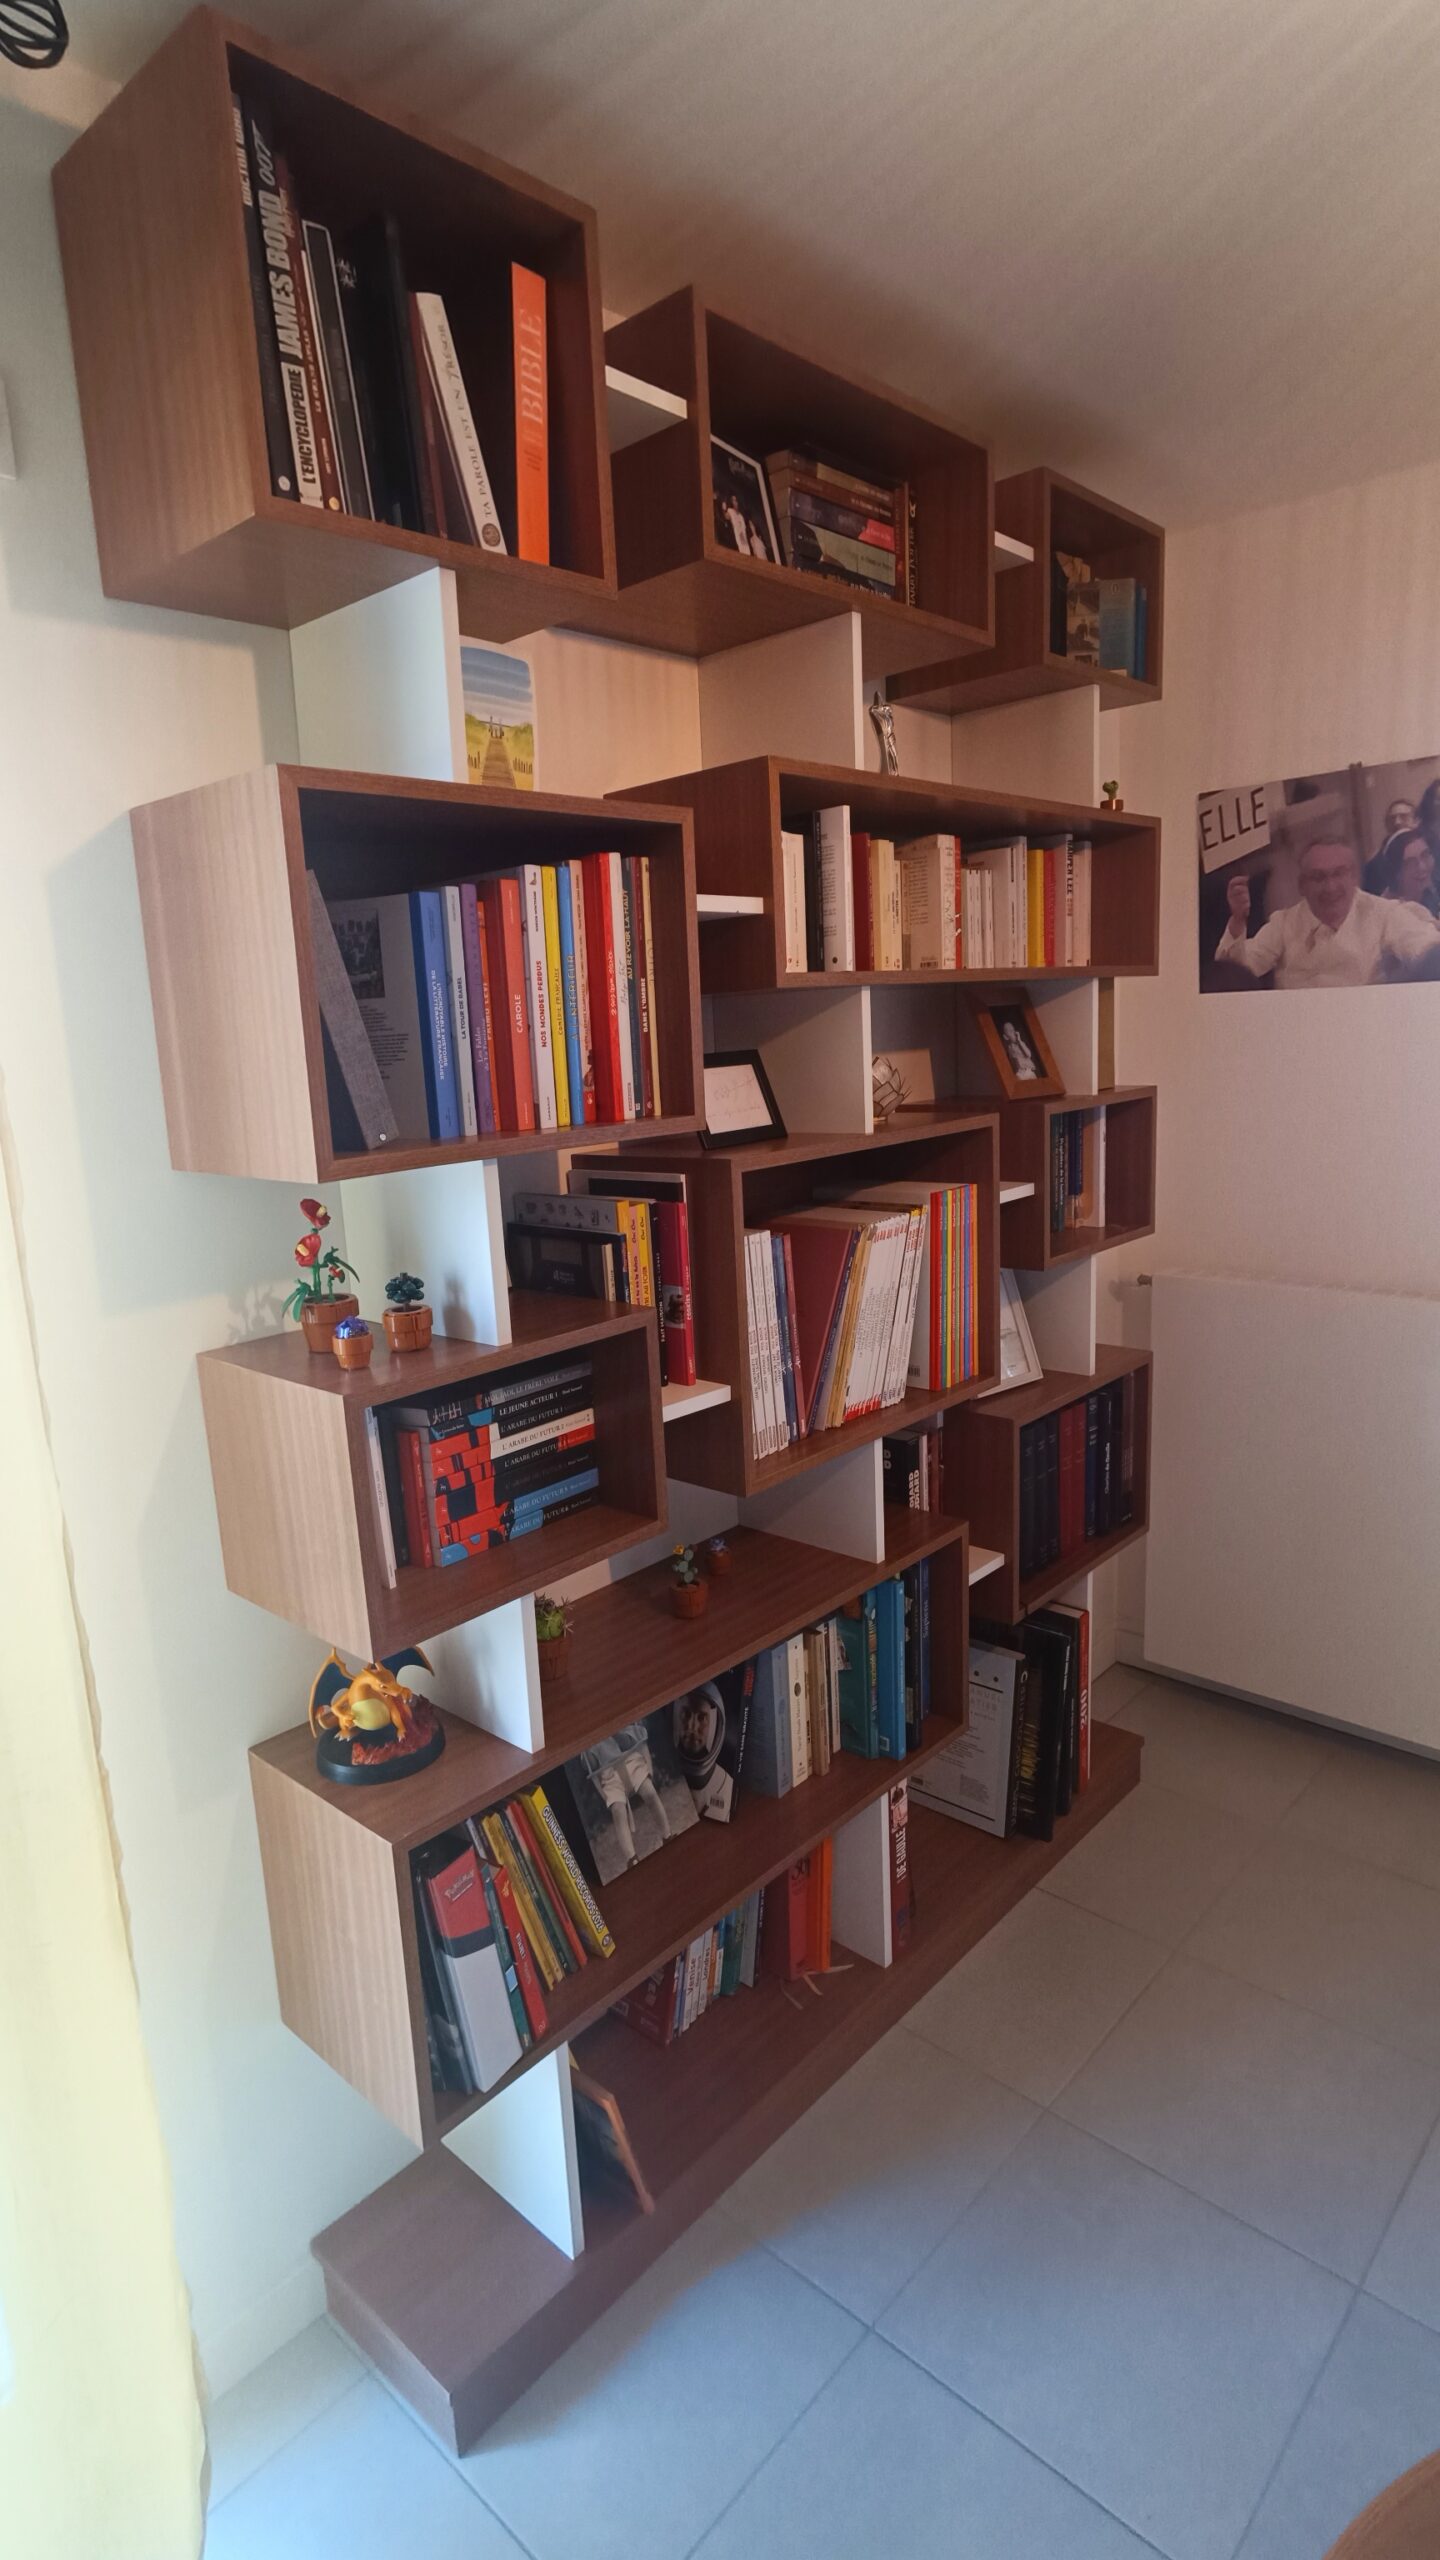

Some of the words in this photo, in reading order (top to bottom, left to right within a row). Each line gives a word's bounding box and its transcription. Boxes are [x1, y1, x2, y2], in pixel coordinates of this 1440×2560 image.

[251, 119, 276, 187] 007
[258, 189, 291, 272] BOND
[269, 270, 303, 360] JAMES
[519, 307, 544, 425] BIBLE
[460, 415, 474, 440] EST
[468, 443, 487, 496] PAROLE
[483, 500, 493, 518] TA
[1200, 786, 1268, 851] ELLE
[624, 930, 632, 965] REVOIR
[535, 960, 544, 991] PERDUS
[626, 966, 633, 980] AU
[458, 1000, 464, 1010] DE
[514, 994, 524, 1034] CAROLE
[537, 993, 546, 1029] MONDES
[641, 1012, 649, 1033] DANS
[462, 1029, 467, 1040] LA
[499, 1406, 508, 1417] LE
[508, 1400, 529, 1415] JEUNE
[529, 1393, 554, 1407] ACTEUR
[528, 1414, 538, 1424] DU
[538, 1408, 560, 1421] FUTUR
[529, 1432, 538, 1441] DU
[539, 1425, 561, 1438] FUTUR
[531, 1449, 541, 1458] DU
[542, 1805, 566, 1849] GUINNESS
[561, 1846, 581, 1879] WORLD
[575, 1871, 600, 1915] RECORDS
[897, 1827, 907, 1864] GAULLE
[687, 1958, 697, 1997] Venise
